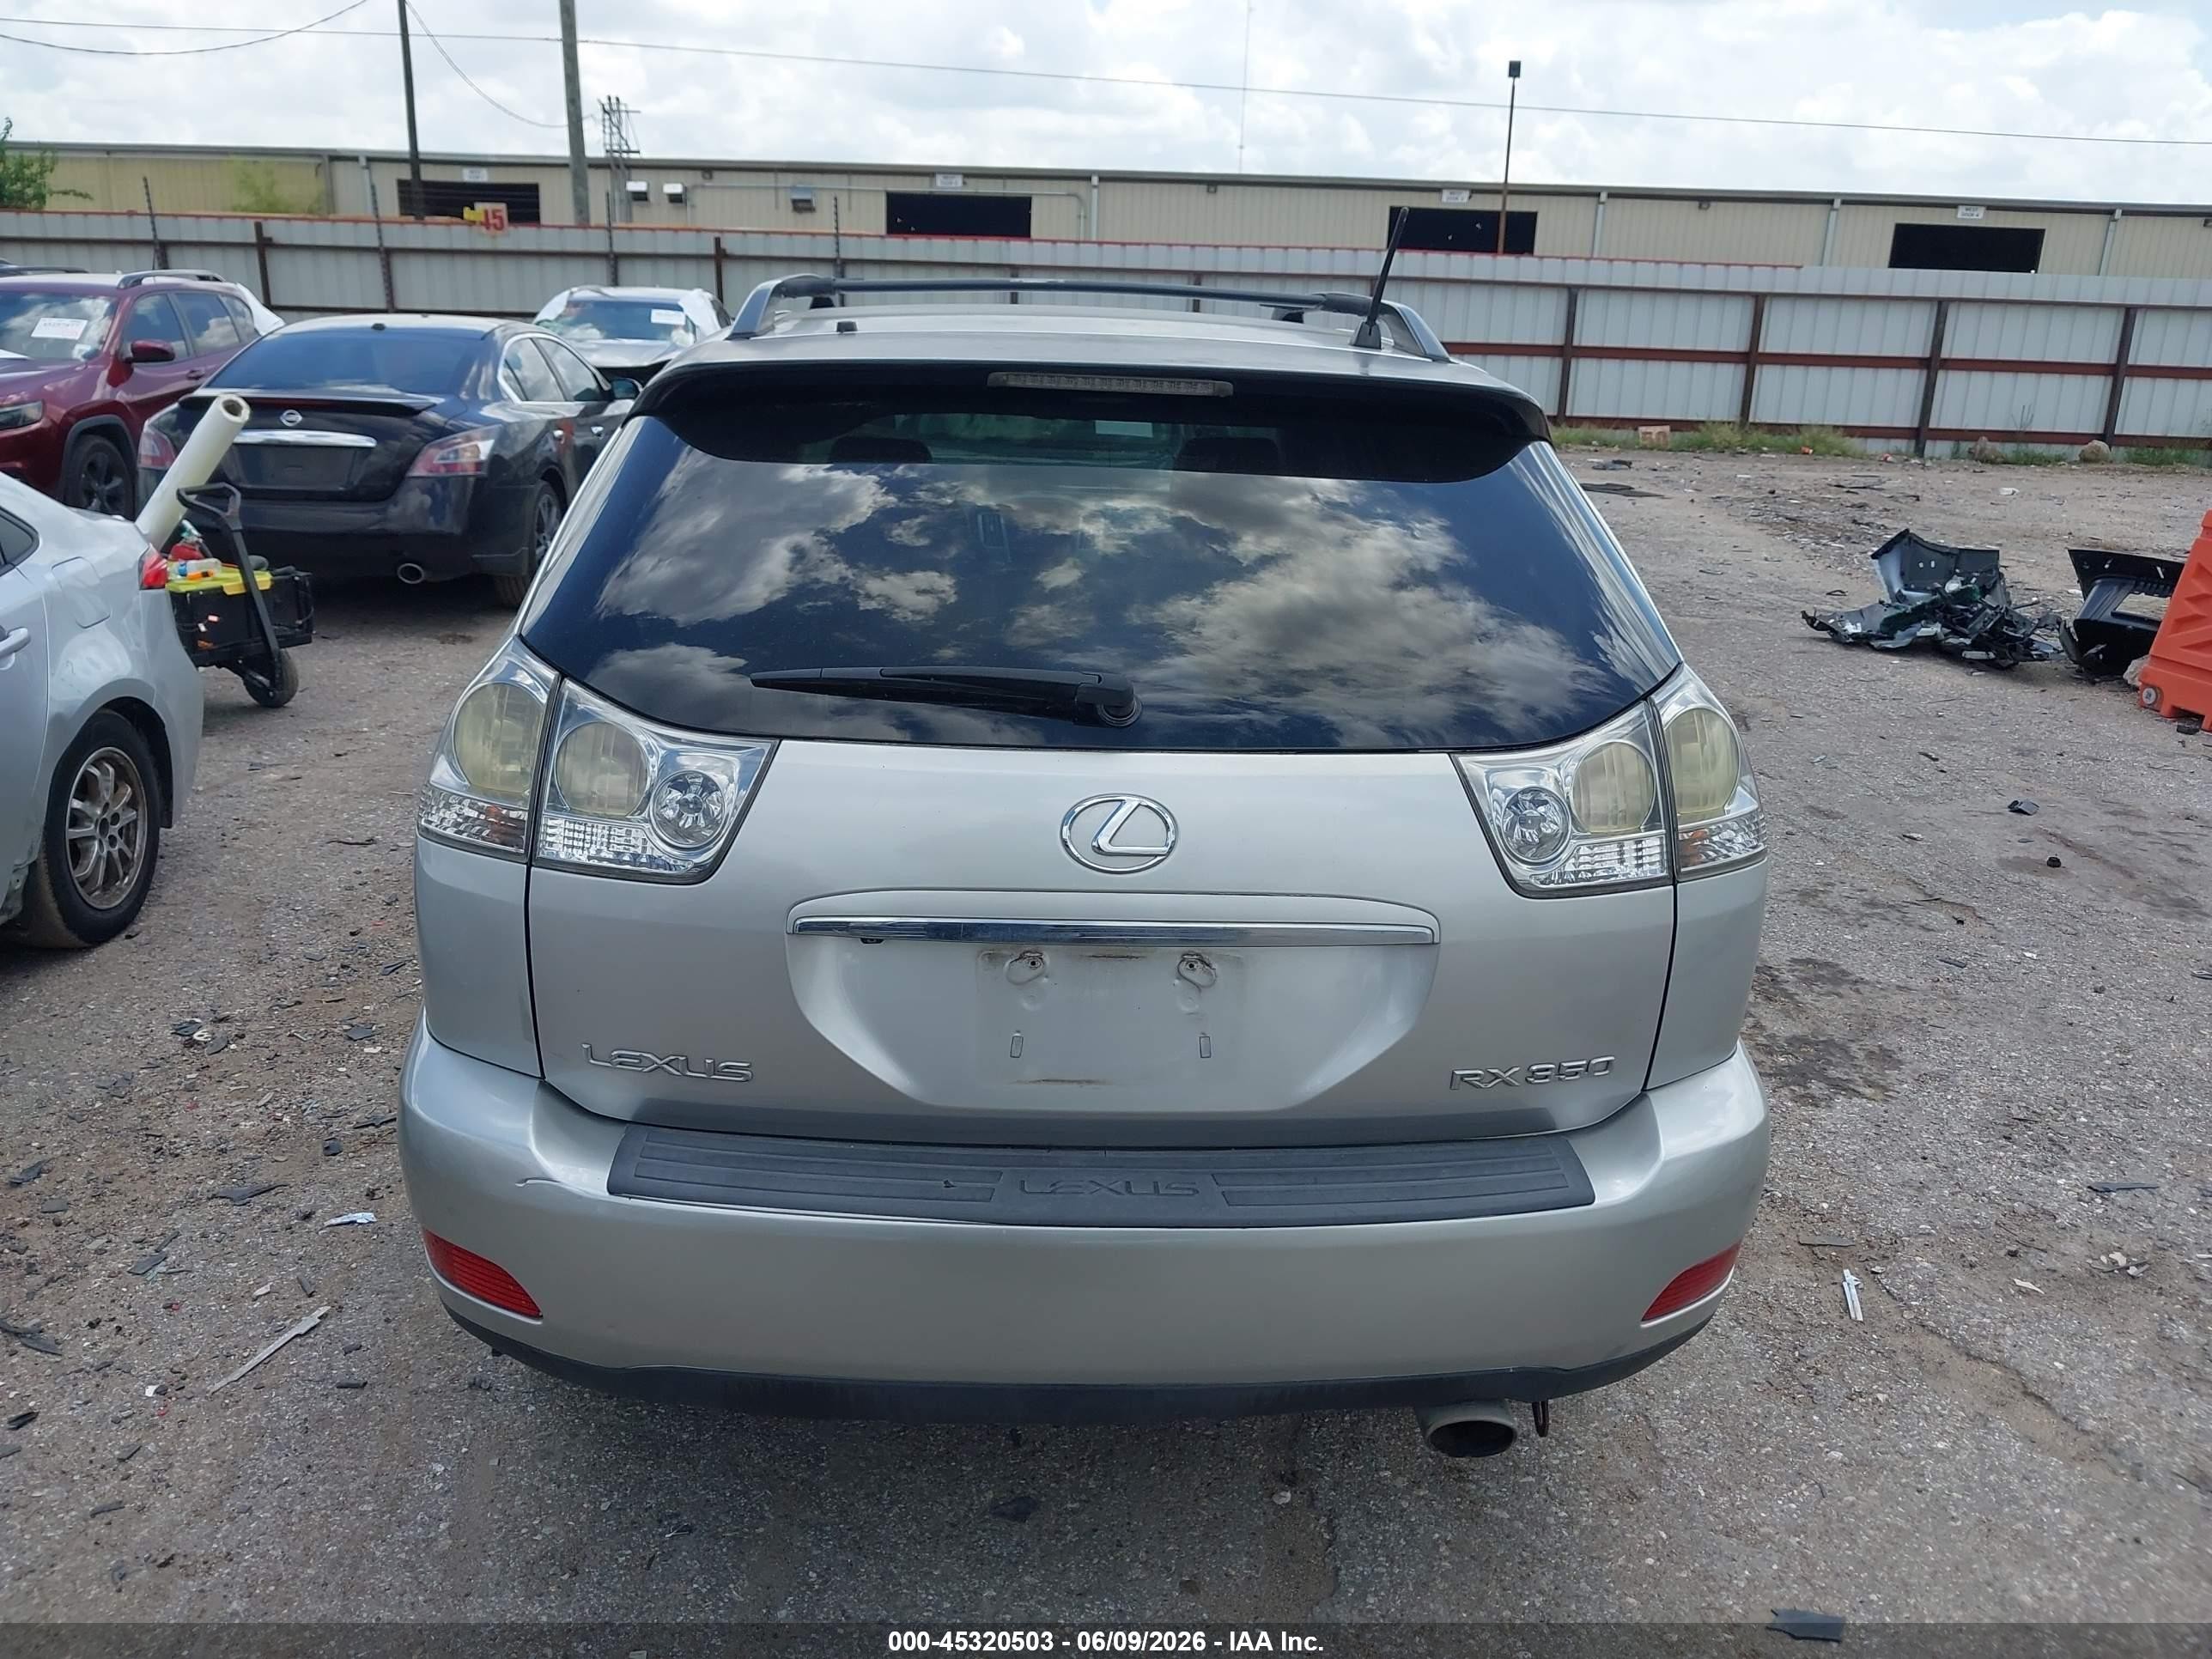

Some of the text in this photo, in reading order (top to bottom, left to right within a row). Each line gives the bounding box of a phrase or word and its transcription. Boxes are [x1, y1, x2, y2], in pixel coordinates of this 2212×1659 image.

[581, 1043, 753, 1082] LEXUS
[1449, 1055, 1615, 1091] RX 350
[1019, 1179, 1200, 1196] LEXUS
